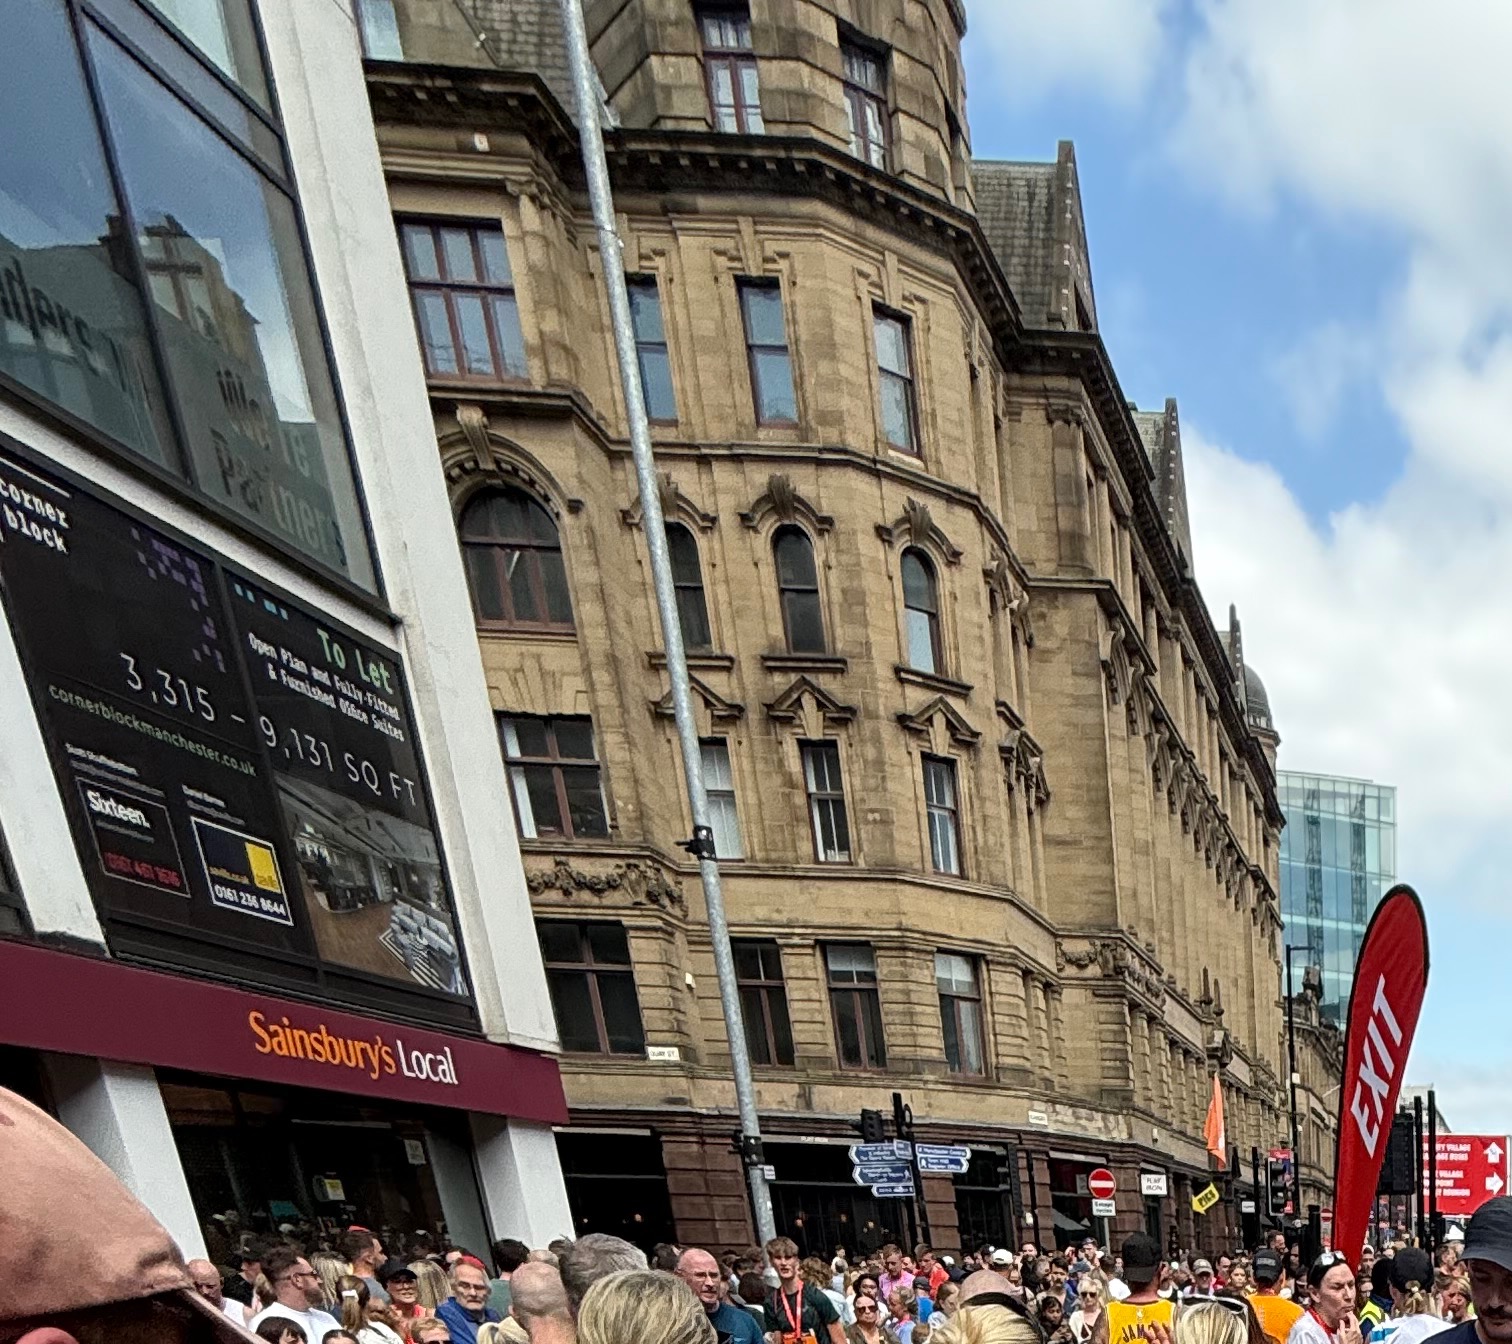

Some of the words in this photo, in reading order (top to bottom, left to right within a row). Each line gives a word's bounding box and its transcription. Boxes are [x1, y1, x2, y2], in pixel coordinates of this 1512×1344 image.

[3, 503, 69, 556] block
[248, 632, 278, 660] Open
[280, 647, 308, 675] Plan
[311, 666, 332, 687] and
[317, 627, 346, 670] To
[355, 649, 393, 695] Let
[49, 685, 257, 777] cornerblockmanchester.co.uk
[119, 652, 216, 721] 3,315
[259, 715, 334, 772] 9,131
[344, 752, 382, 796] SQ
[390, 772, 416, 806] FT
[280, 666, 337, 709] Furnished
[339, 699, 369, 725] Office
[372, 713, 405, 742] Suites
[215, 884, 238, 904] 0161
[249, 1010, 397, 1080] Sainsbury's
[396, 1039, 459, 1085] Local
[1351, 972, 1403, 1159] EXIT
